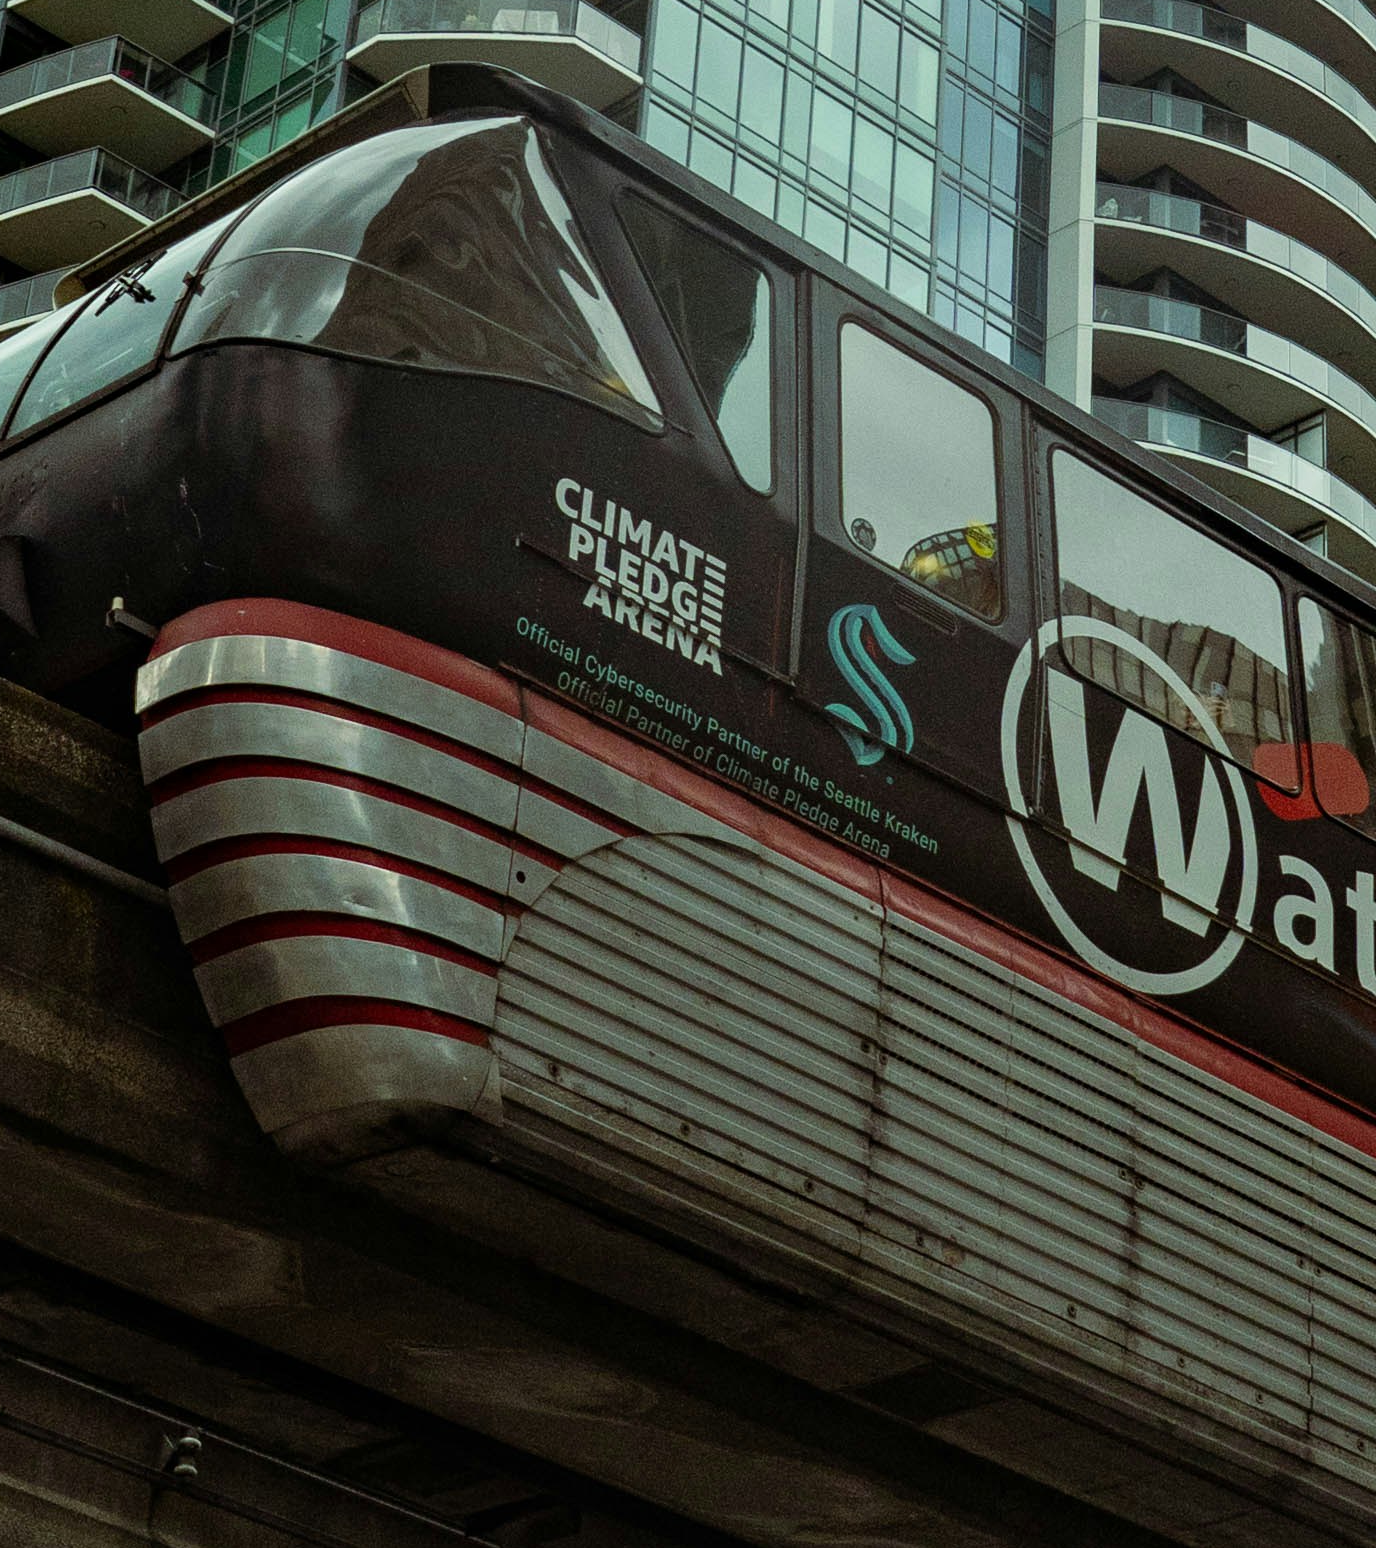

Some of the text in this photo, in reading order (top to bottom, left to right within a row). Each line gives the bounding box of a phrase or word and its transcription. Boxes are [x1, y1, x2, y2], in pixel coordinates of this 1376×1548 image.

[555, 477, 727, 597] CLIMATE
[569, 523, 724, 637] PLEDGE
[582, 575, 723, 677] ARENA
[516, 616, 939, 854] Official Cybersecurity Partner of the Seattle Kraken
[558, 671, 891, 859] Official Partner of Climate Pledge Arena
